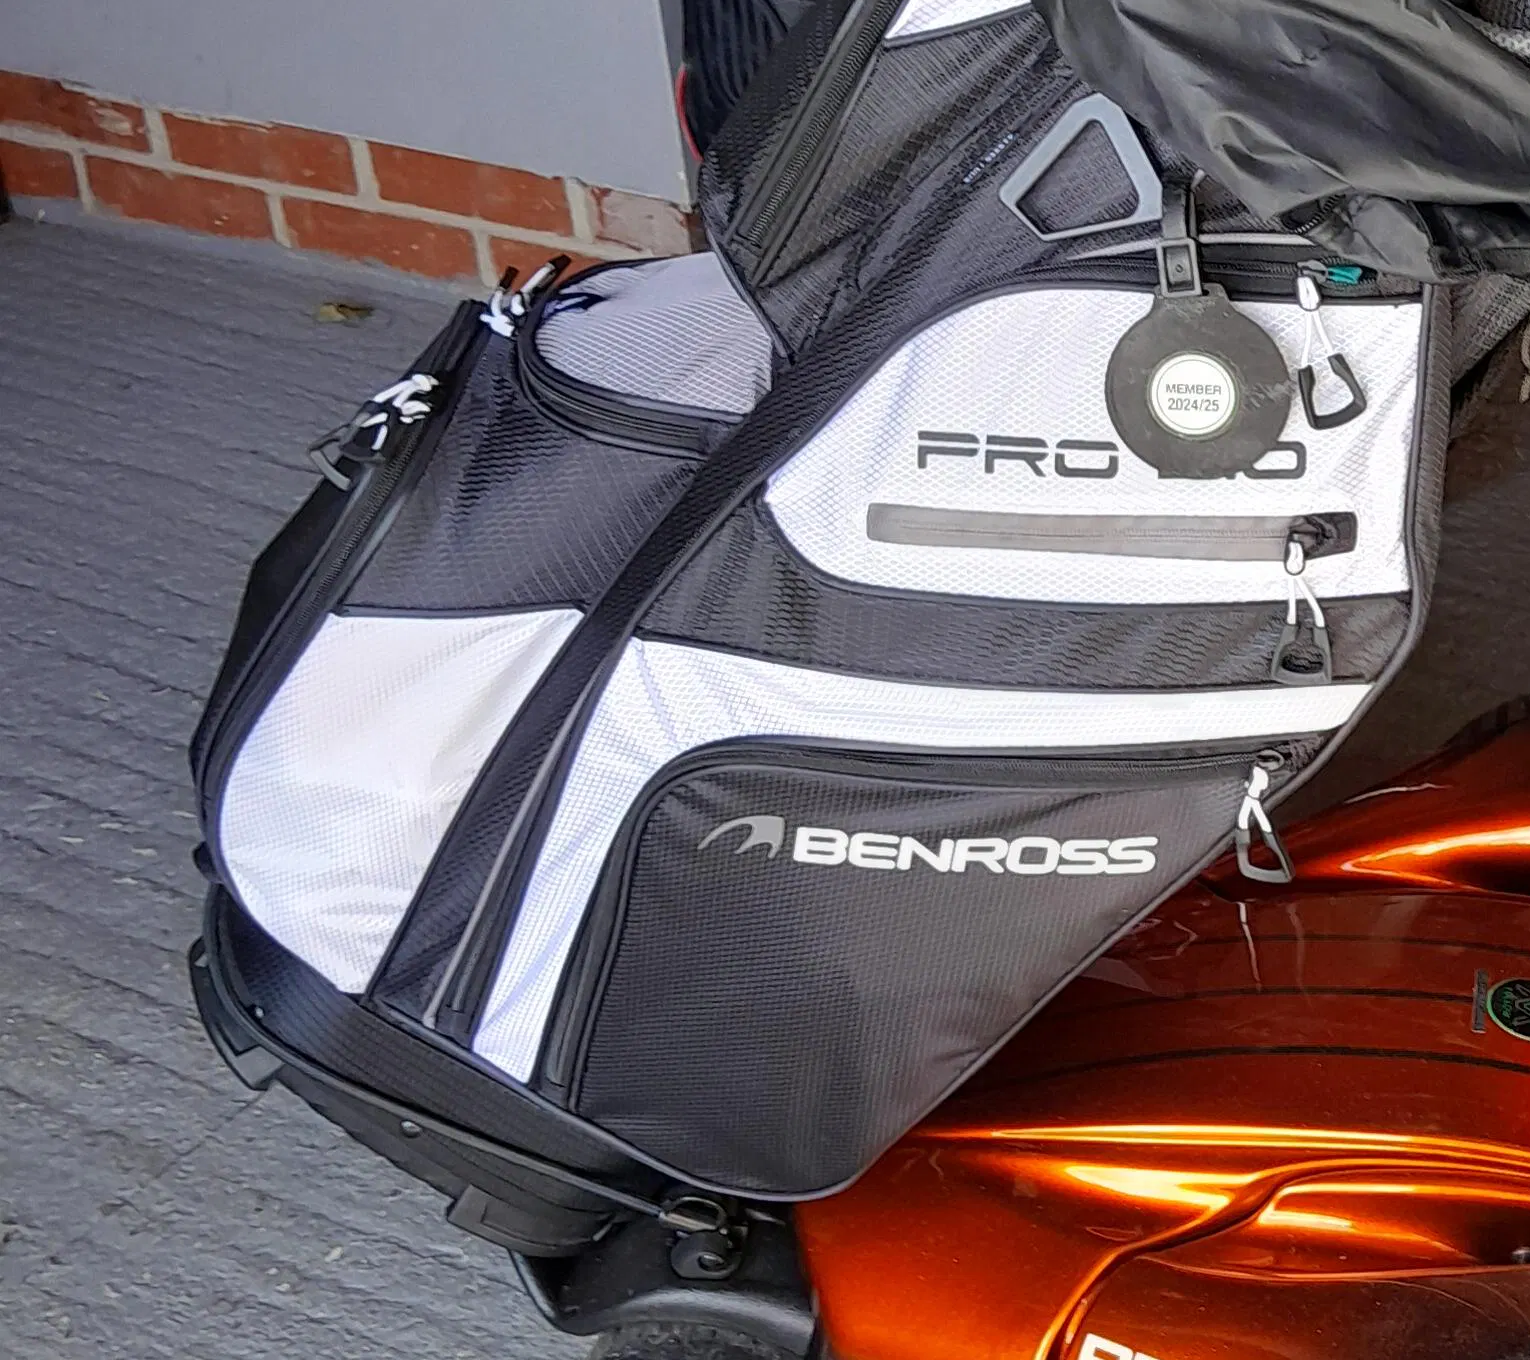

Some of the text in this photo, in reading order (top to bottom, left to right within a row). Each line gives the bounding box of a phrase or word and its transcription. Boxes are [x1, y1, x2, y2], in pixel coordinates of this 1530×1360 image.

[1165, 383, 1222, 396] MEMBER
[1167, 397, 1220, 413] 2024/25
[917, 429, 1119, 480] PRO
[792, 826, 1159, 876] BENROSS
